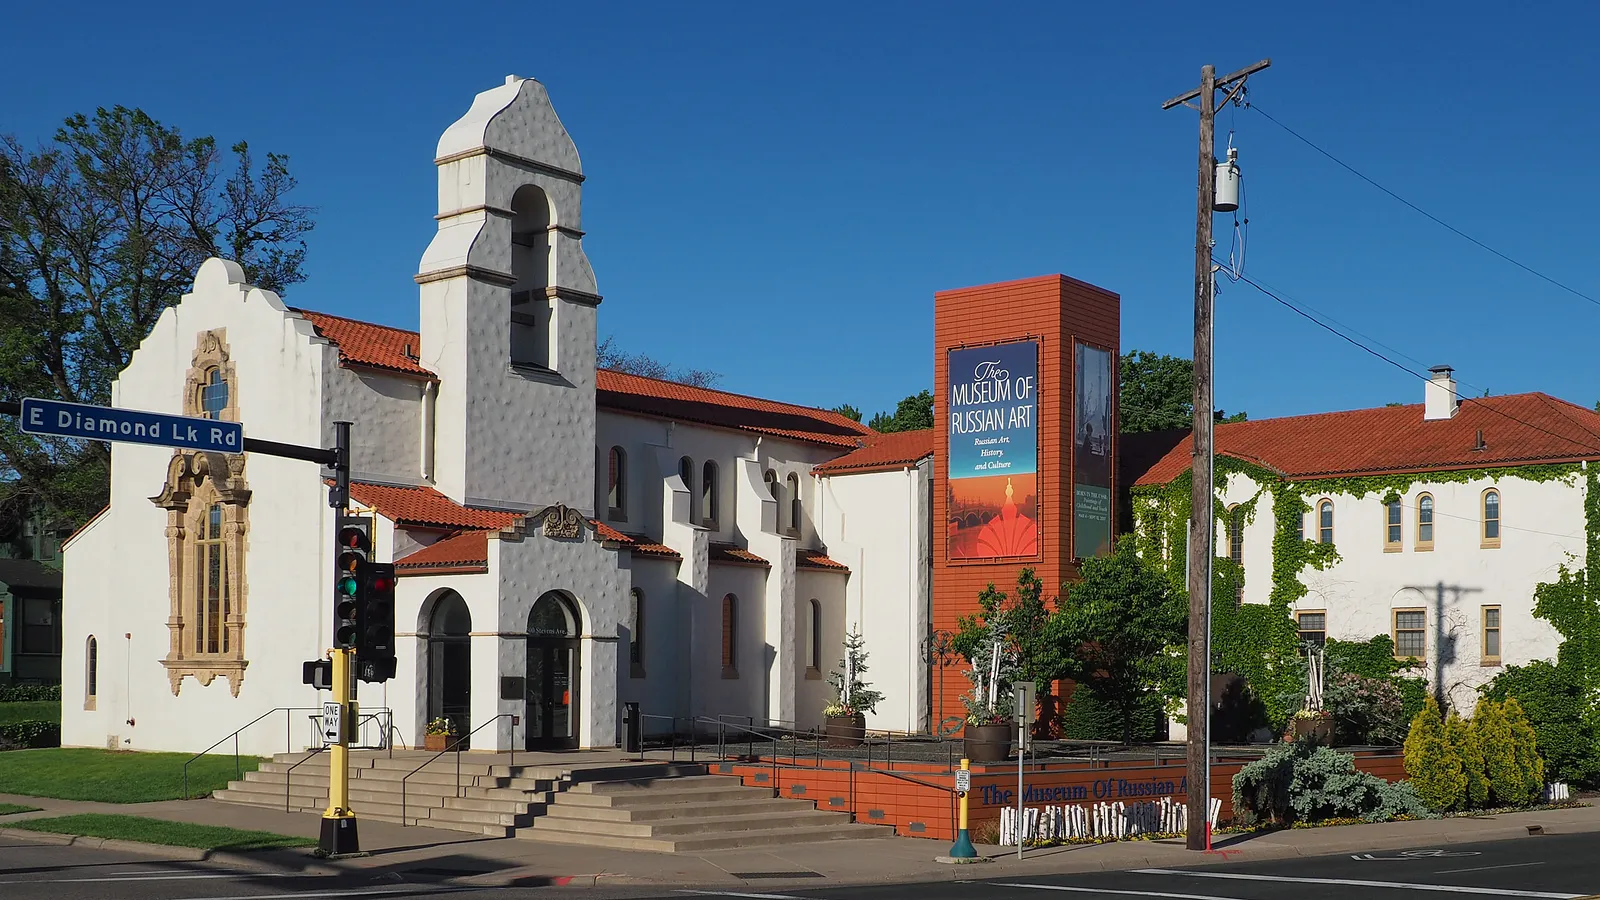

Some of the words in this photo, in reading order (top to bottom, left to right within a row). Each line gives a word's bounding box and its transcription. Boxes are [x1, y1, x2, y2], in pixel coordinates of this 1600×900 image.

[974, 360, 1009, 382] The
[952, 379, 1011, 407] MUSEUM
[1015, 376, 1033, 400] OF
[30, 407, 44, 426] E
[58, 411, 160, 438] Diamond
[172, 423, 198, 442] Lk
[210, 428, 236, 446] Rd
[952, 408, 1004, 434] RUSSIAN
[1008, 405, 1033, 429] ART
[974, 437, 998, 446] Russian
[974, 462, 987, 470] and
[987, 460, 1011, 469] Culture
[325, 706, 338, 716] ONE
[325, 717, 338, 727] WAY
[980, 784, 1013, 805] The
[1022, 783, 1088, 803] Museum
[1093, 778, 1114, 799] Of
[1118, 776, 1175, 798] Russian
